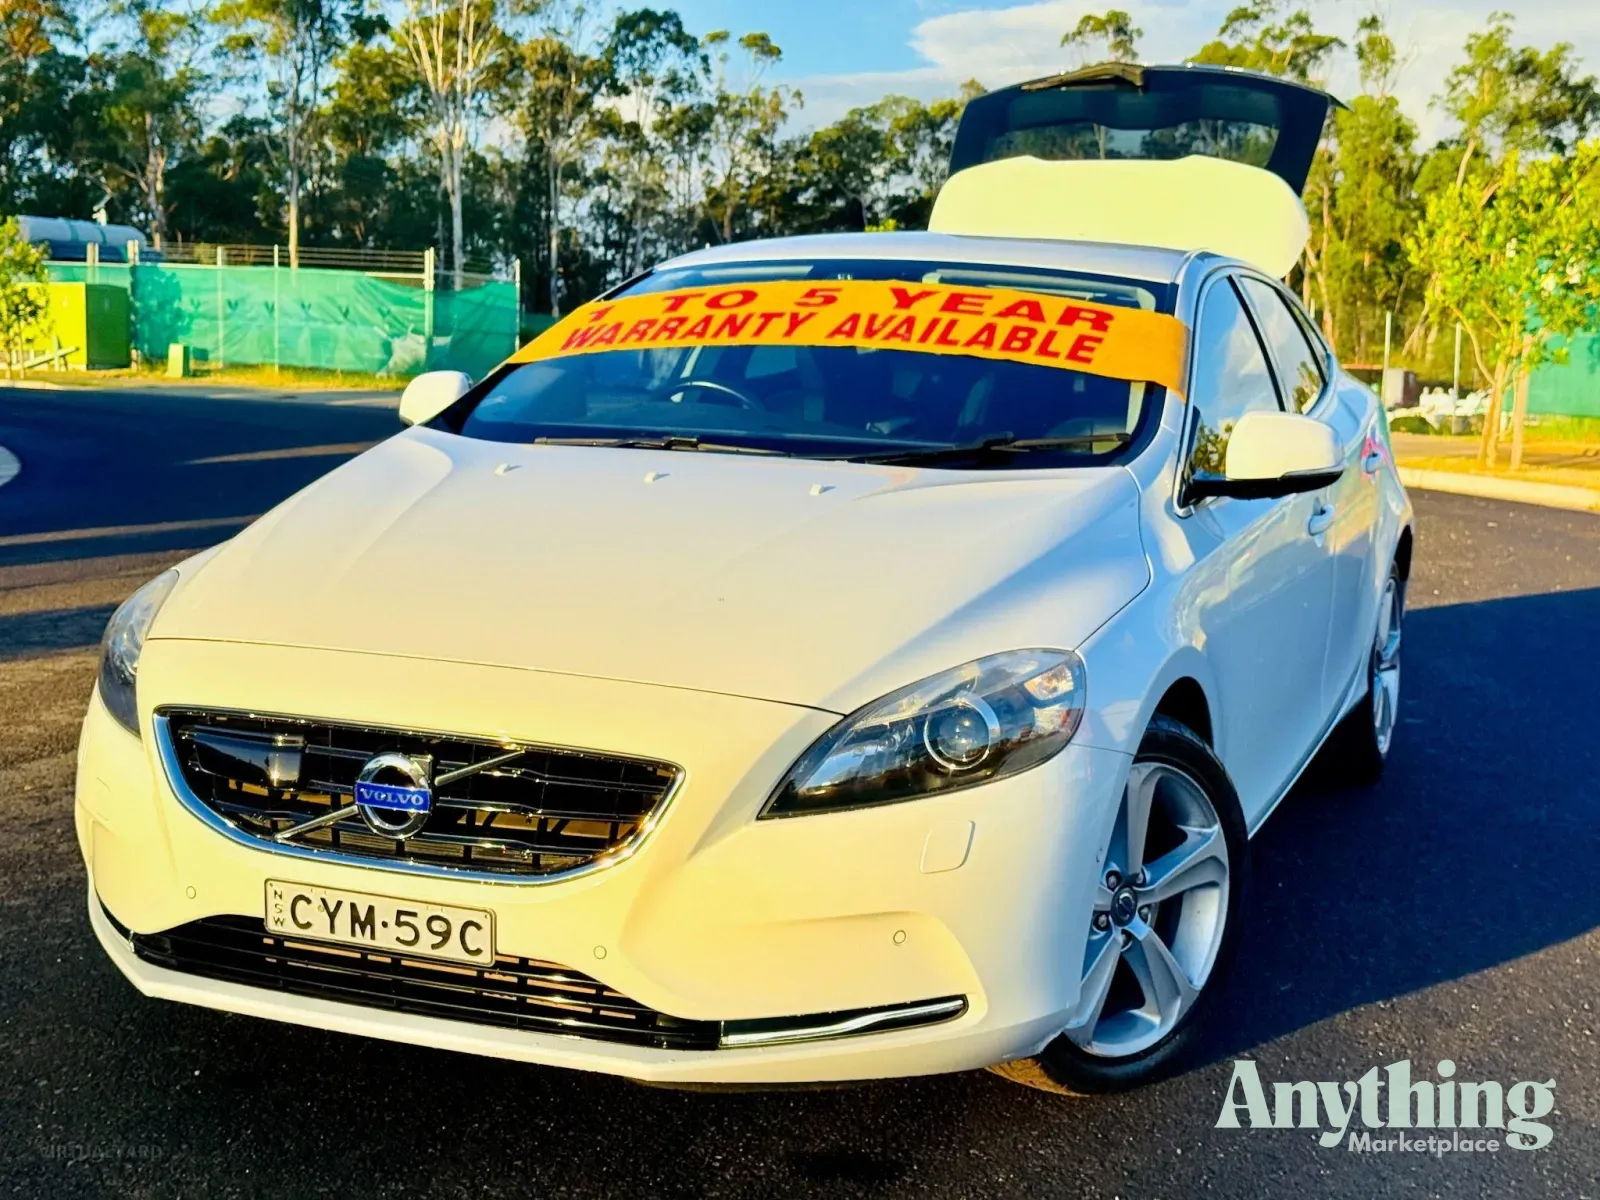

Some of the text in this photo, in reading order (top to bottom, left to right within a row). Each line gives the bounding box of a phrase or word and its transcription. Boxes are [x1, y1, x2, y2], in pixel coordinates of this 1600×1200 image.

[662, 289, 759, 314] TO
[793, 287, 843, 308] 5
[889, 287, 1116, 333] YEAR
[559, 311, 1106, 365] WARRANTY AVAILABLE
[361, 787, 425, 806] VOLVO
